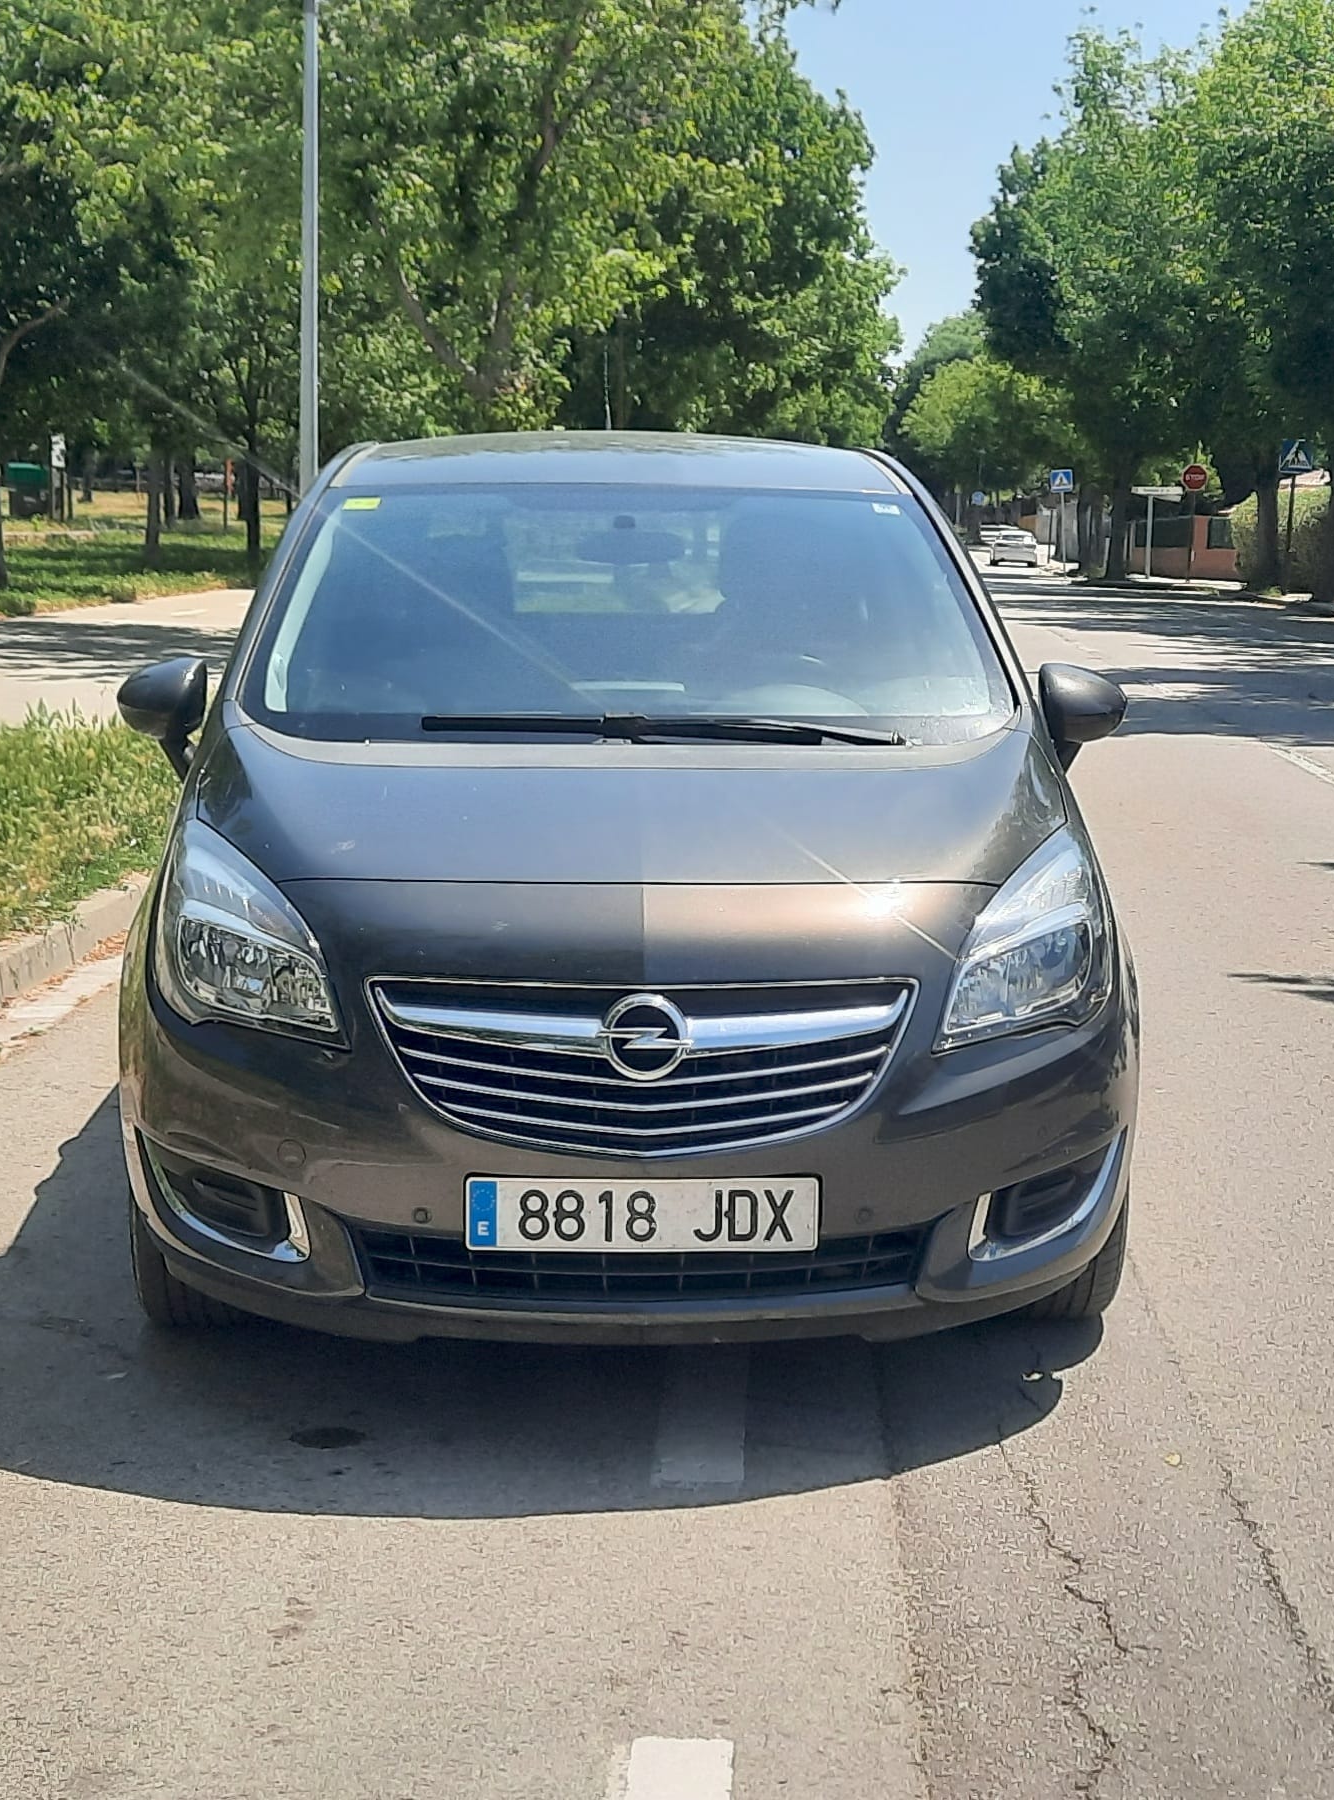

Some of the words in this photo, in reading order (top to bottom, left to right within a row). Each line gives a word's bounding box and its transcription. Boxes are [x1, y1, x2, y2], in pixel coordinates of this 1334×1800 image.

[478, 1221, 489, 1236] E
[518, 1189, 657, 1242] 8818
[693, 1189, 795, 1242] JDX
